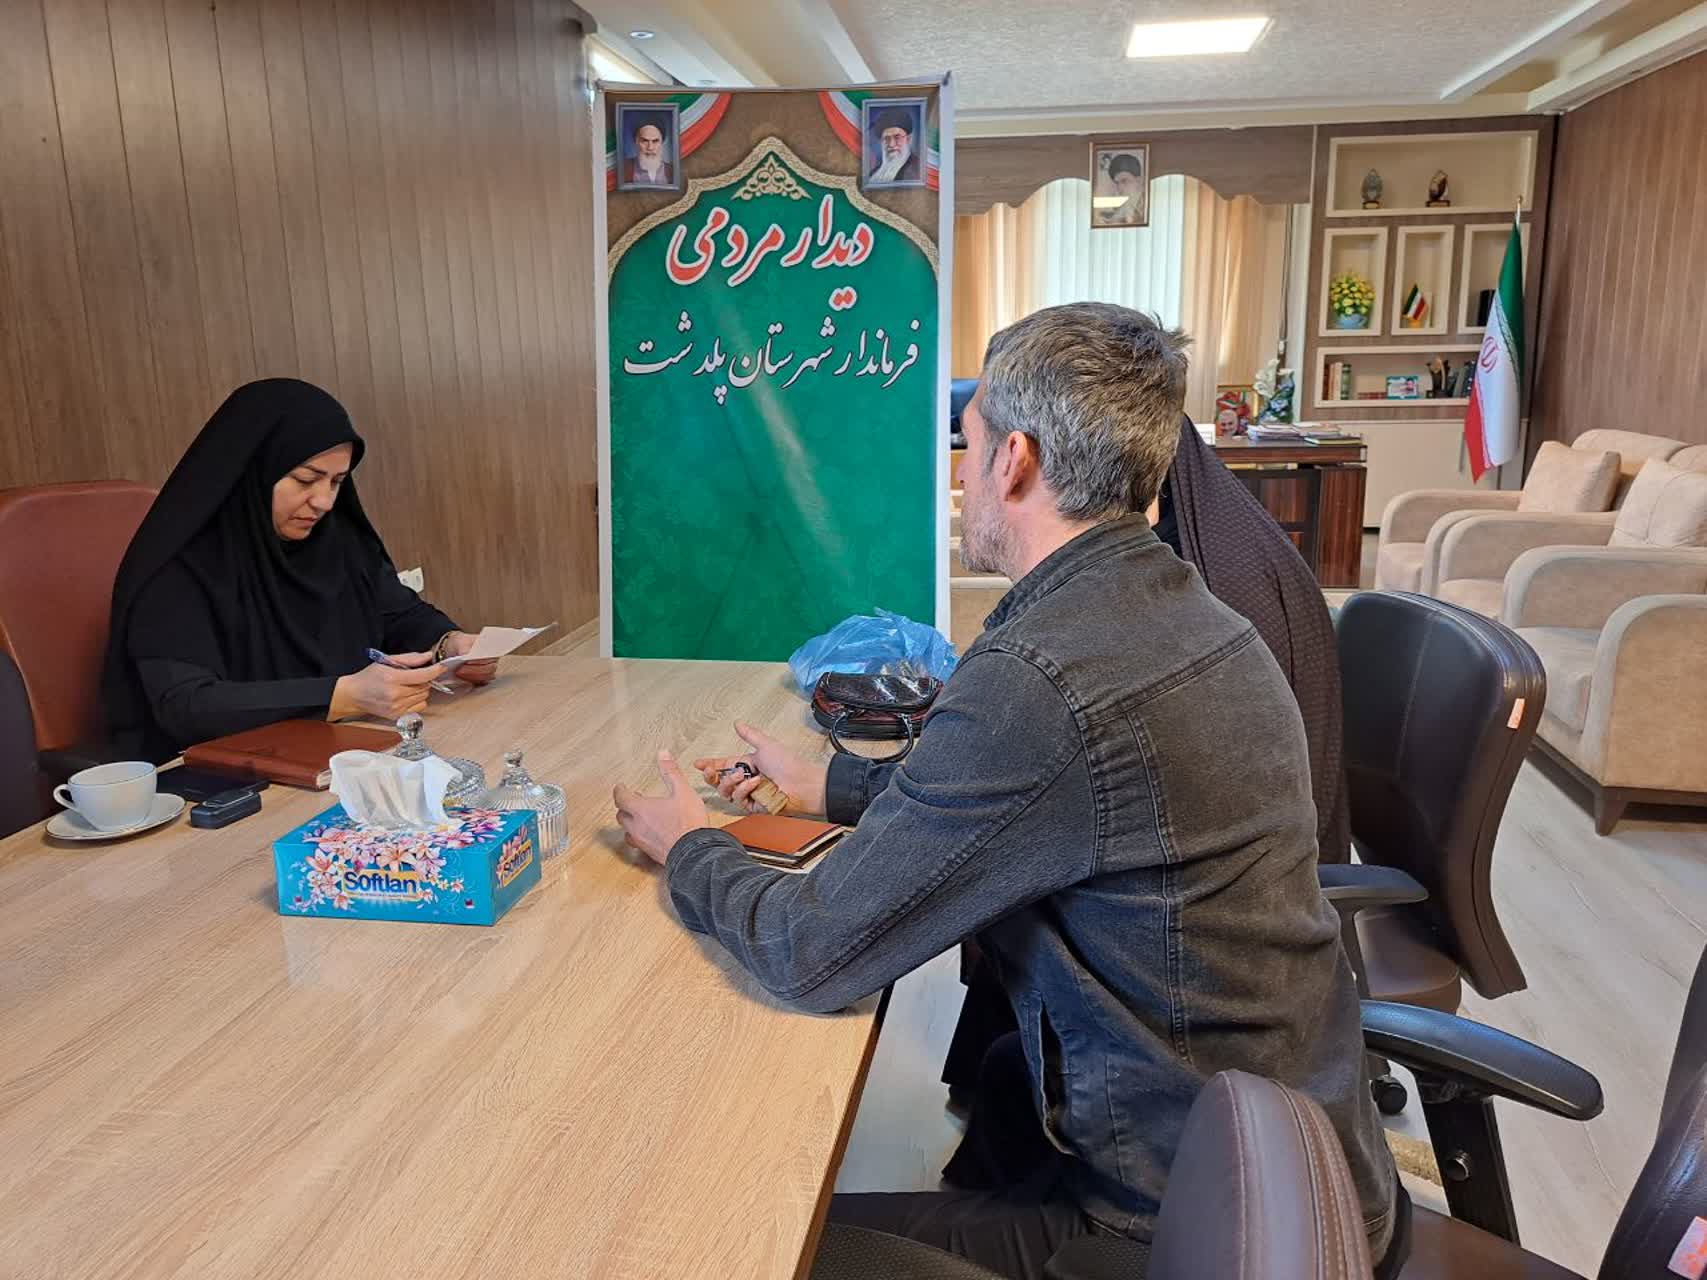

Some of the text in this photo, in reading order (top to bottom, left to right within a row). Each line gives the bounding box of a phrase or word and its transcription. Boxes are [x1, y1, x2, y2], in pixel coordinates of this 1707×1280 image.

[667, 195, 874, 309] دیدار مردمی
[728, 316, 834, 388] شهرستان
[834, 319, 920, 388] فرماندار
[344, 871, 417, 893] Softlan
